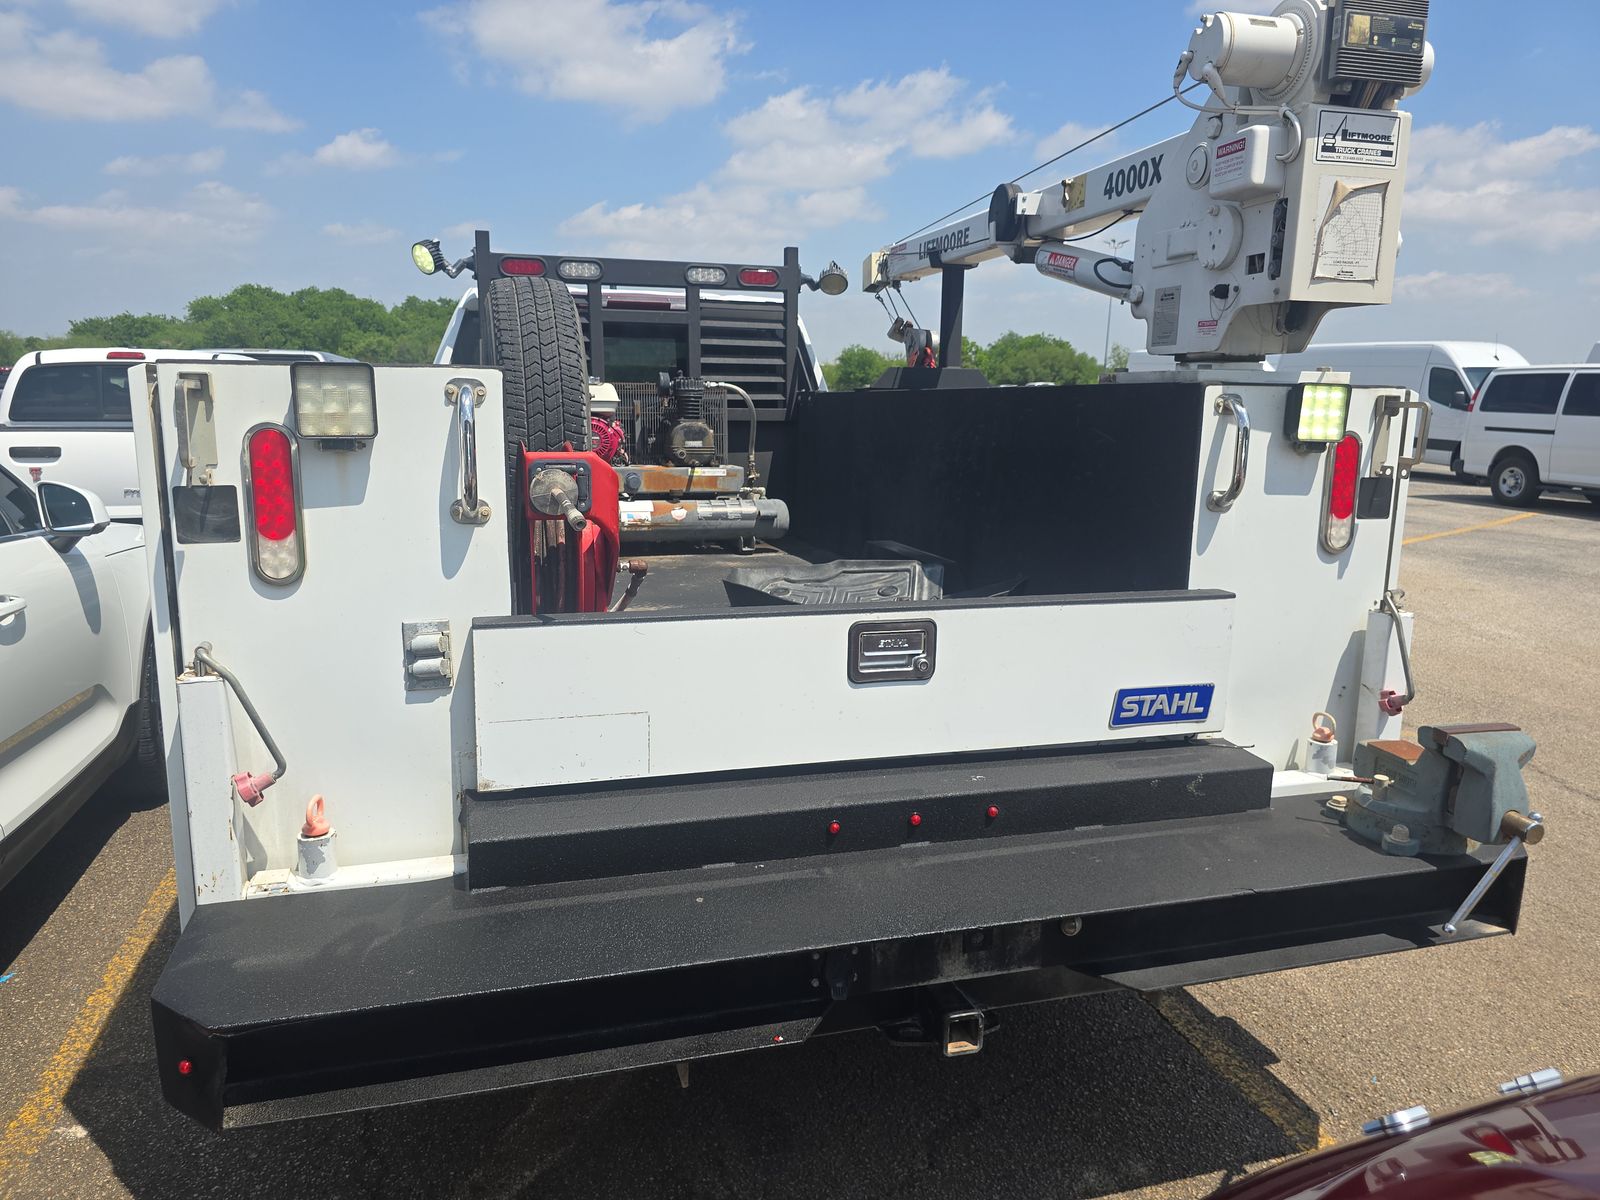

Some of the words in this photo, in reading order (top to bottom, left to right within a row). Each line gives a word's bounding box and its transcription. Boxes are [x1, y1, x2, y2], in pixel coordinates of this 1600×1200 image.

[1341, 129, 1392, 142] LIFTMOORE
[1217, 140, 1246, 157] WARNING!
[1335, 146, 1356, 154] TRUCK
[1356, 148, 1382, 156] CRANES
[1103, 154, 1165, 200] 4000X
[1055, 254, 1077, 270] DANGER
[1119, 692, 1204, 718] STAHL
